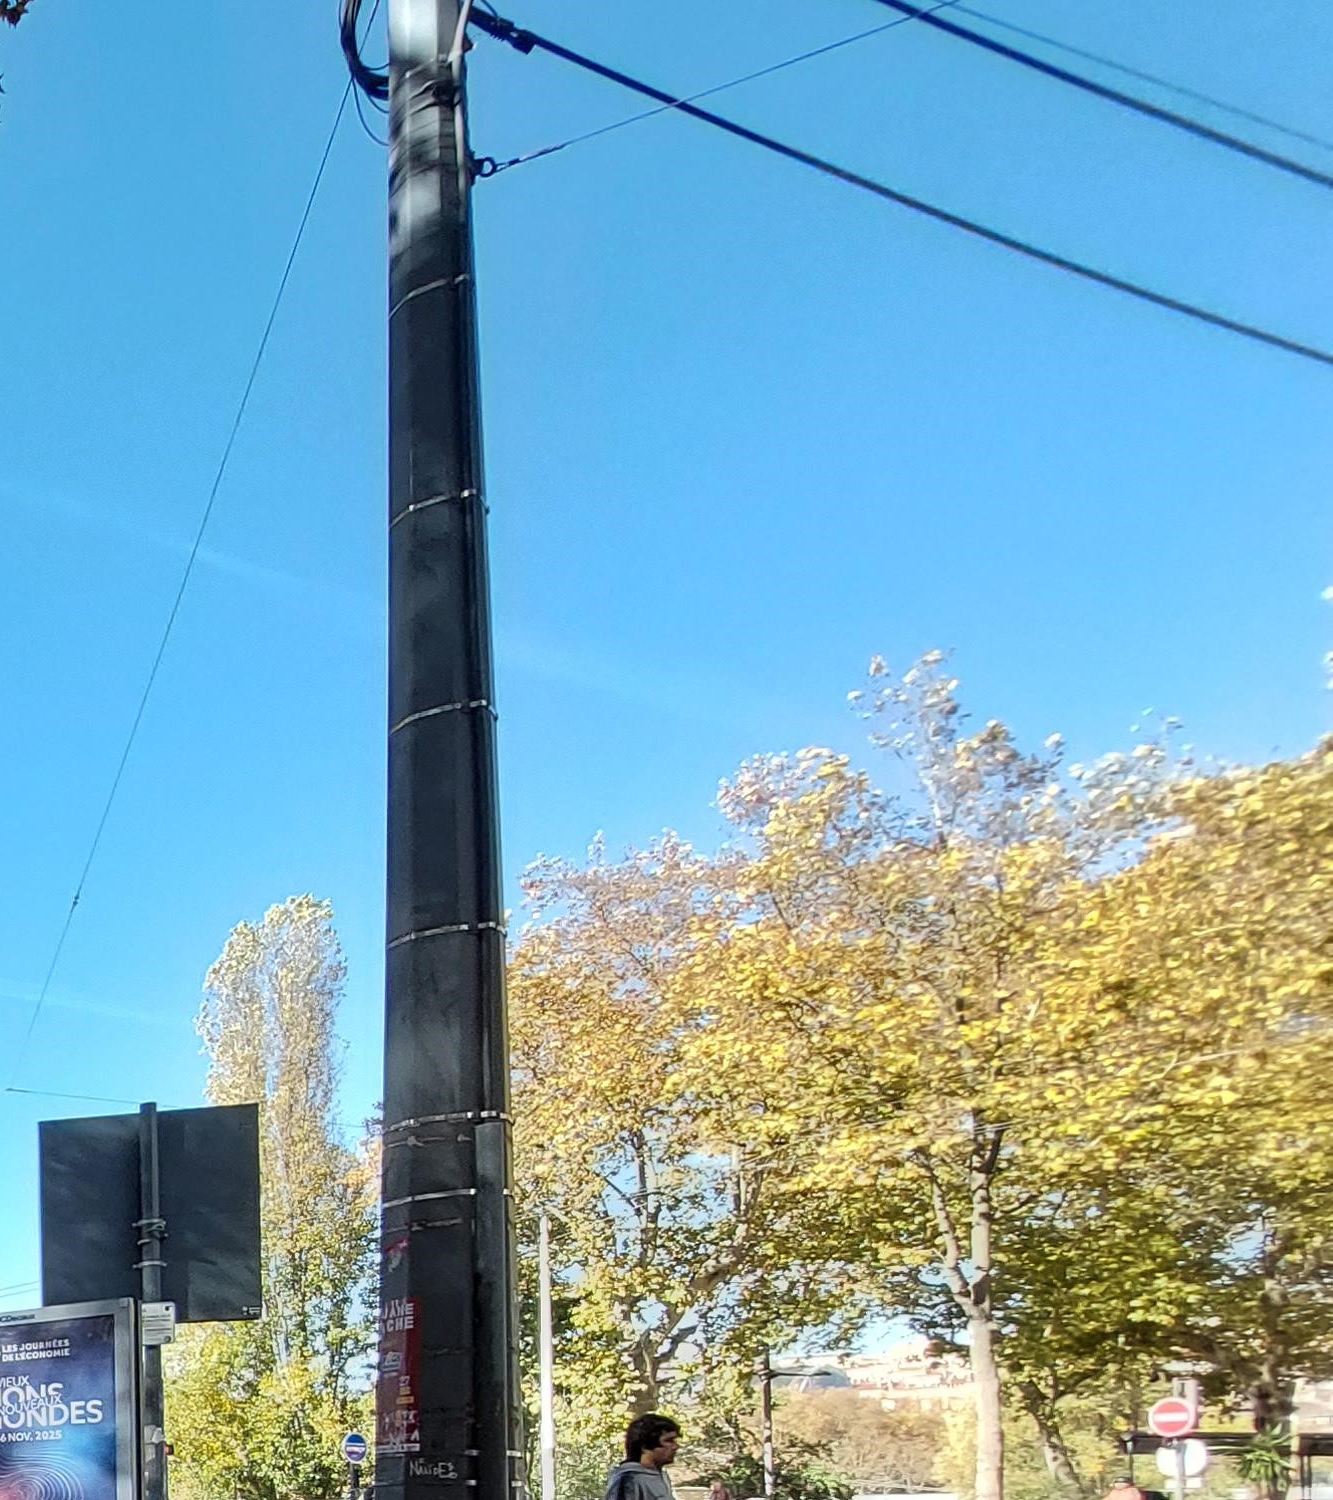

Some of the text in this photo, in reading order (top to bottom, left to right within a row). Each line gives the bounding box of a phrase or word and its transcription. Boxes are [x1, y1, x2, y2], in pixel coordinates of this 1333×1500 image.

[1, 1338, 70, 1353] LES JOURNÉES
[1, 1354, 14, 1362] DE
[7, 1431, 34, 1443] NOV.
[35, 1429, 63, 1441] 2025
